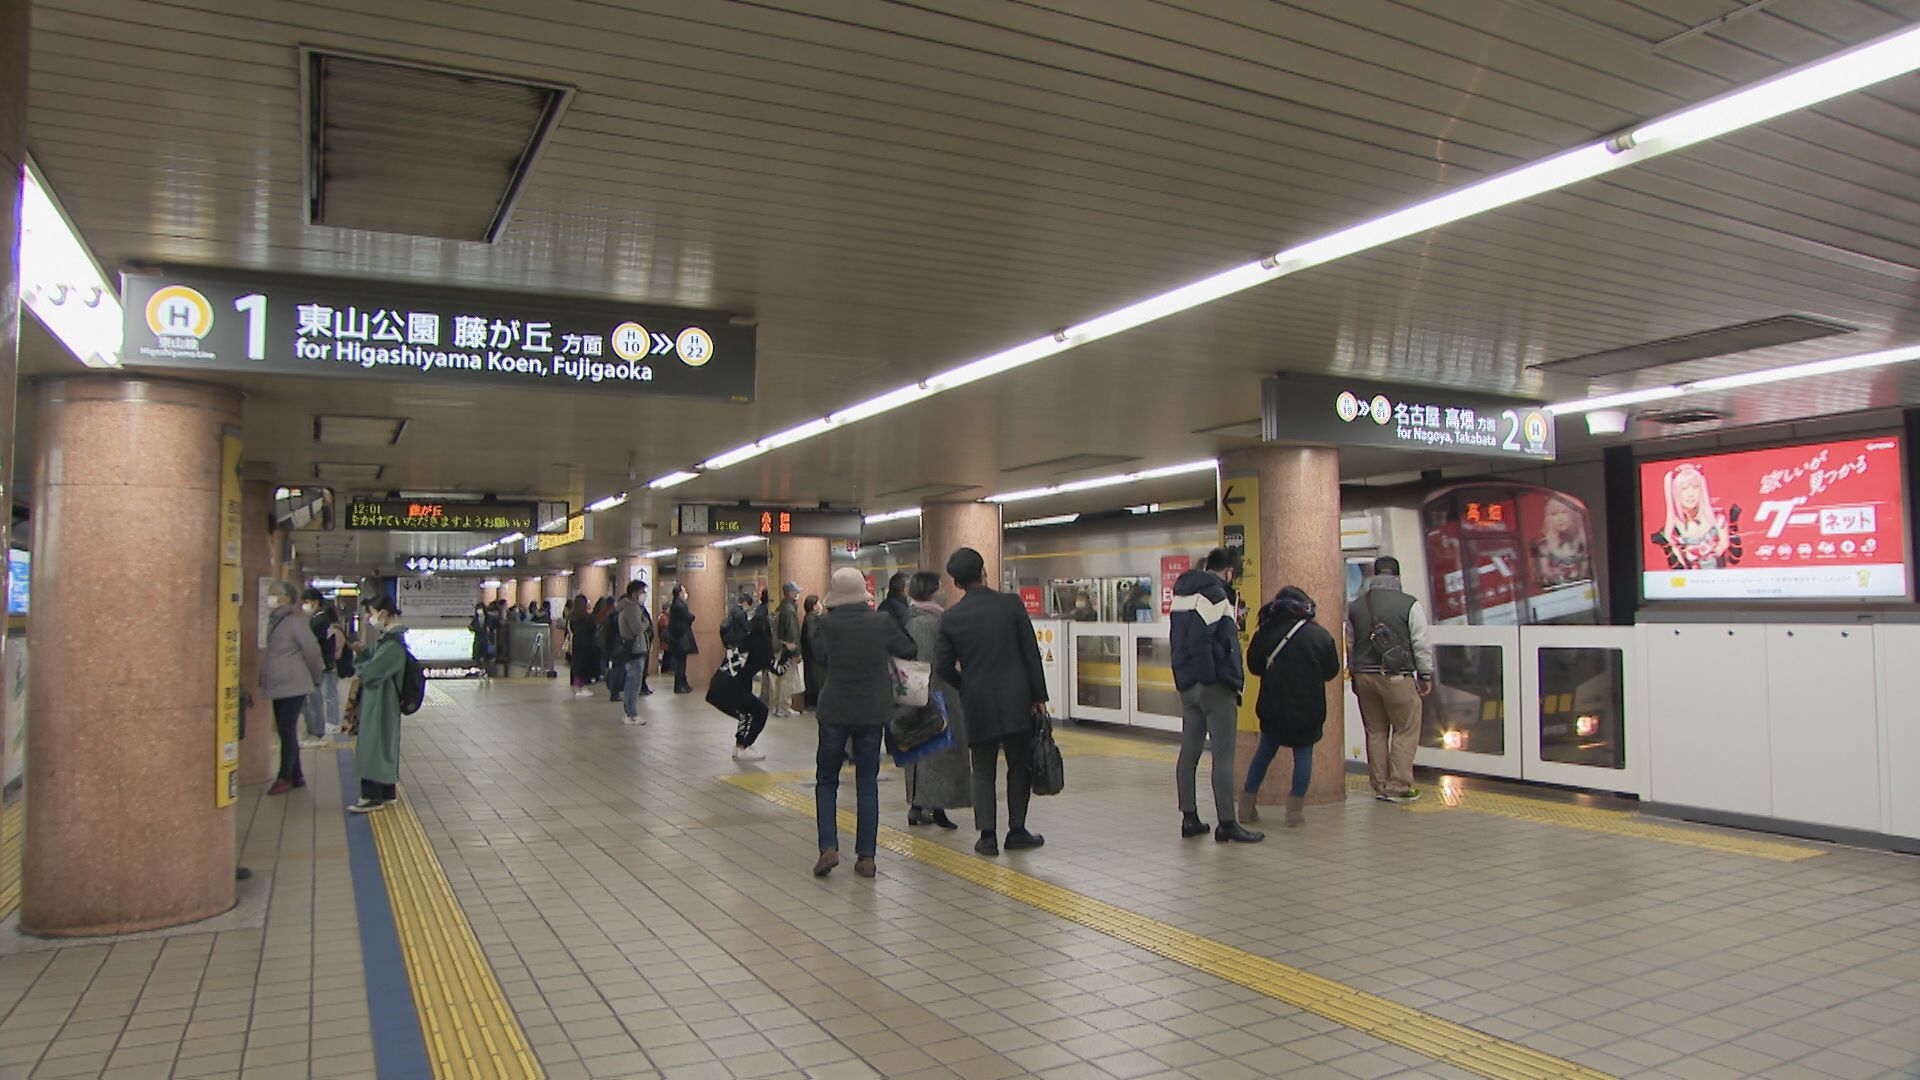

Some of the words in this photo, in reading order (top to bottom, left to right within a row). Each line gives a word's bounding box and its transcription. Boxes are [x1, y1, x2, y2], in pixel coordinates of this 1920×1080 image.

[168, 305, 189, 327] H
[234, 293, 267, 360] 1
[295, 303, 440, 346] 東山公園
[454, 315, 553, 353] 藤が丘
[562, 333, 603, 356] 方面
[295, 337, 331, 360] for
[336, 341, 482, 372] Higashiyama
[488, 351, 547, 377] Koen,
[553, 356, 653, 382] Fujigaoka
[624, 341, 640, 354] 10
[686, 346, 703, 358] 22
[1394, 402, 1440, 428] 名古屋
[1445, 407, 1475, 430] 高畑
[1397, 425, 1412, 439] for
[1414, 427, 1453, 446] Nagoya,
[1455, 431, 1497, 447] Takabata
[1502, 409, 1520, 450] 2
[353, 503, 381, 514] 12:01
